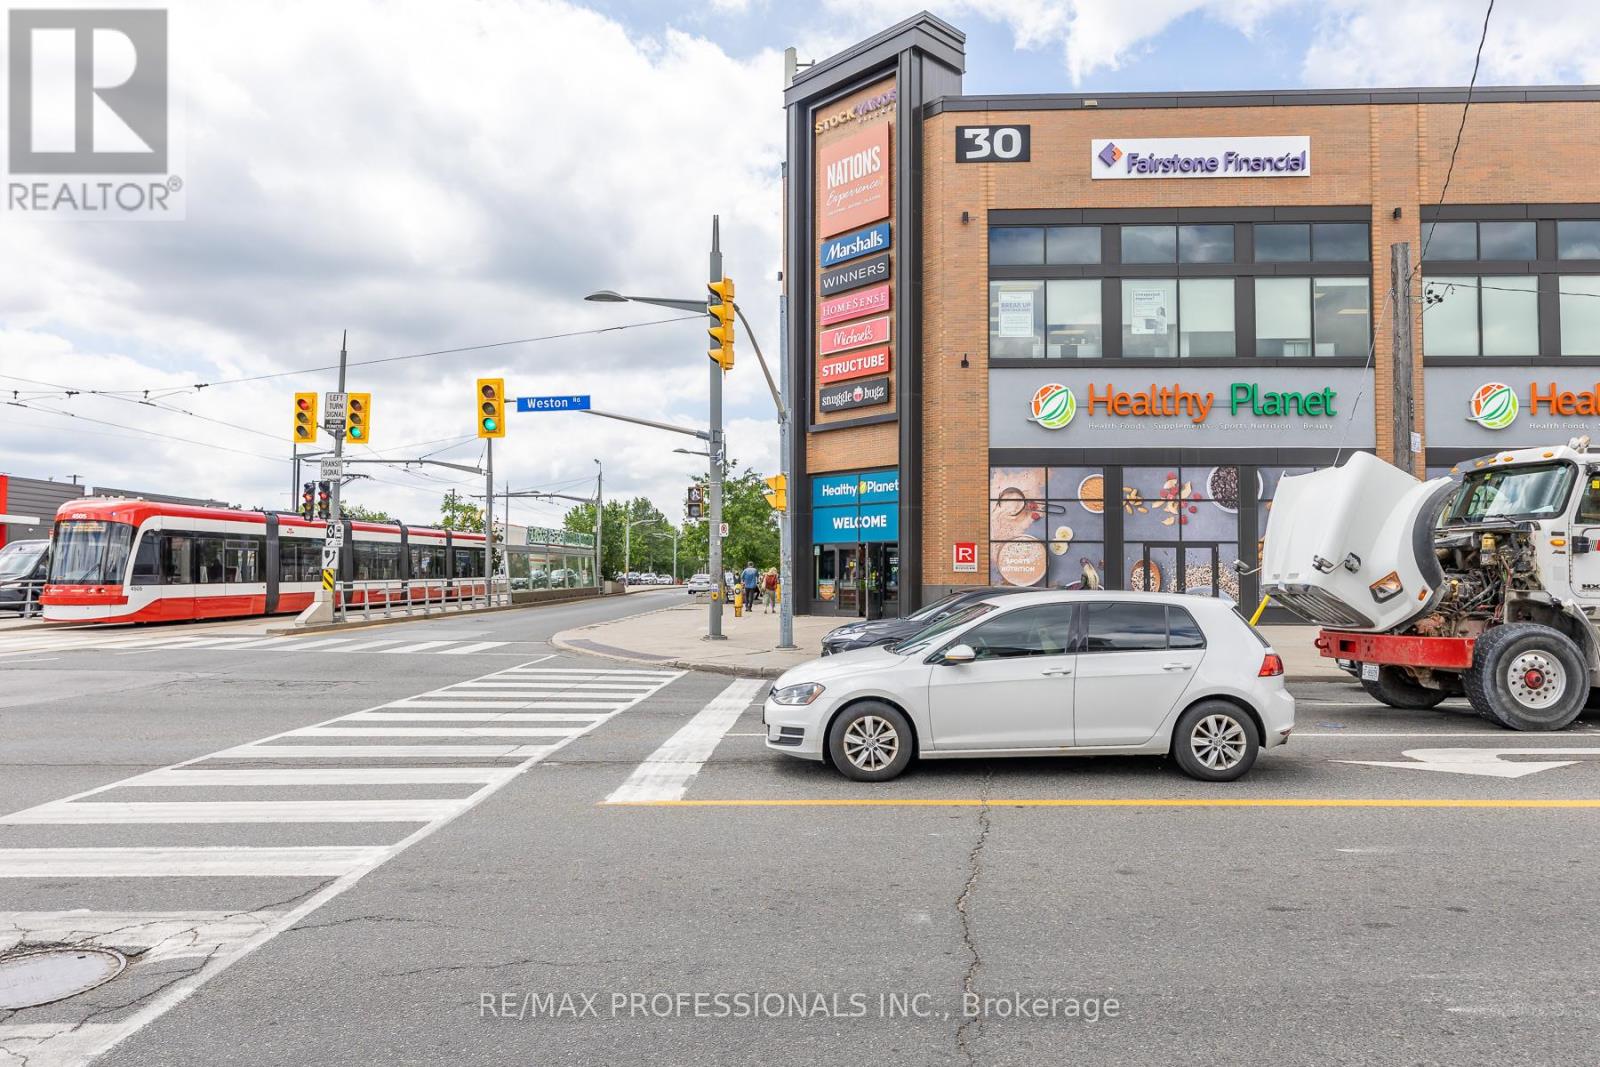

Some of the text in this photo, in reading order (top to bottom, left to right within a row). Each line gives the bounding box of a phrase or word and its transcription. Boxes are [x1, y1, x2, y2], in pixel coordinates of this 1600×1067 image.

[963, 127, 1023, 159] 30
[827, 146, 881, 189] NATIONS
[1127, 150, 1307, 174] Fairstone Financial
[825, 230, 883, 262] Marshalls
[823, 262, 886, 288] WINNERS
[833, 325, 873, 347] Michaels
[822, 354, 885, 377] STRUCTUBE
[329, 402, 344, 410] TURN
[527, 398, 568, 409] Weston
[822, 385, 884, 407] snuggle bugz
[1087, 383, 1337, 424] Healthy Planet
[1303, 423, 1334, 431] Beauty
[822, 480, 899, 497] Healthy Planet
[833, 515, 887, 530] WELCOME
[958, 547, 973, 561] R
